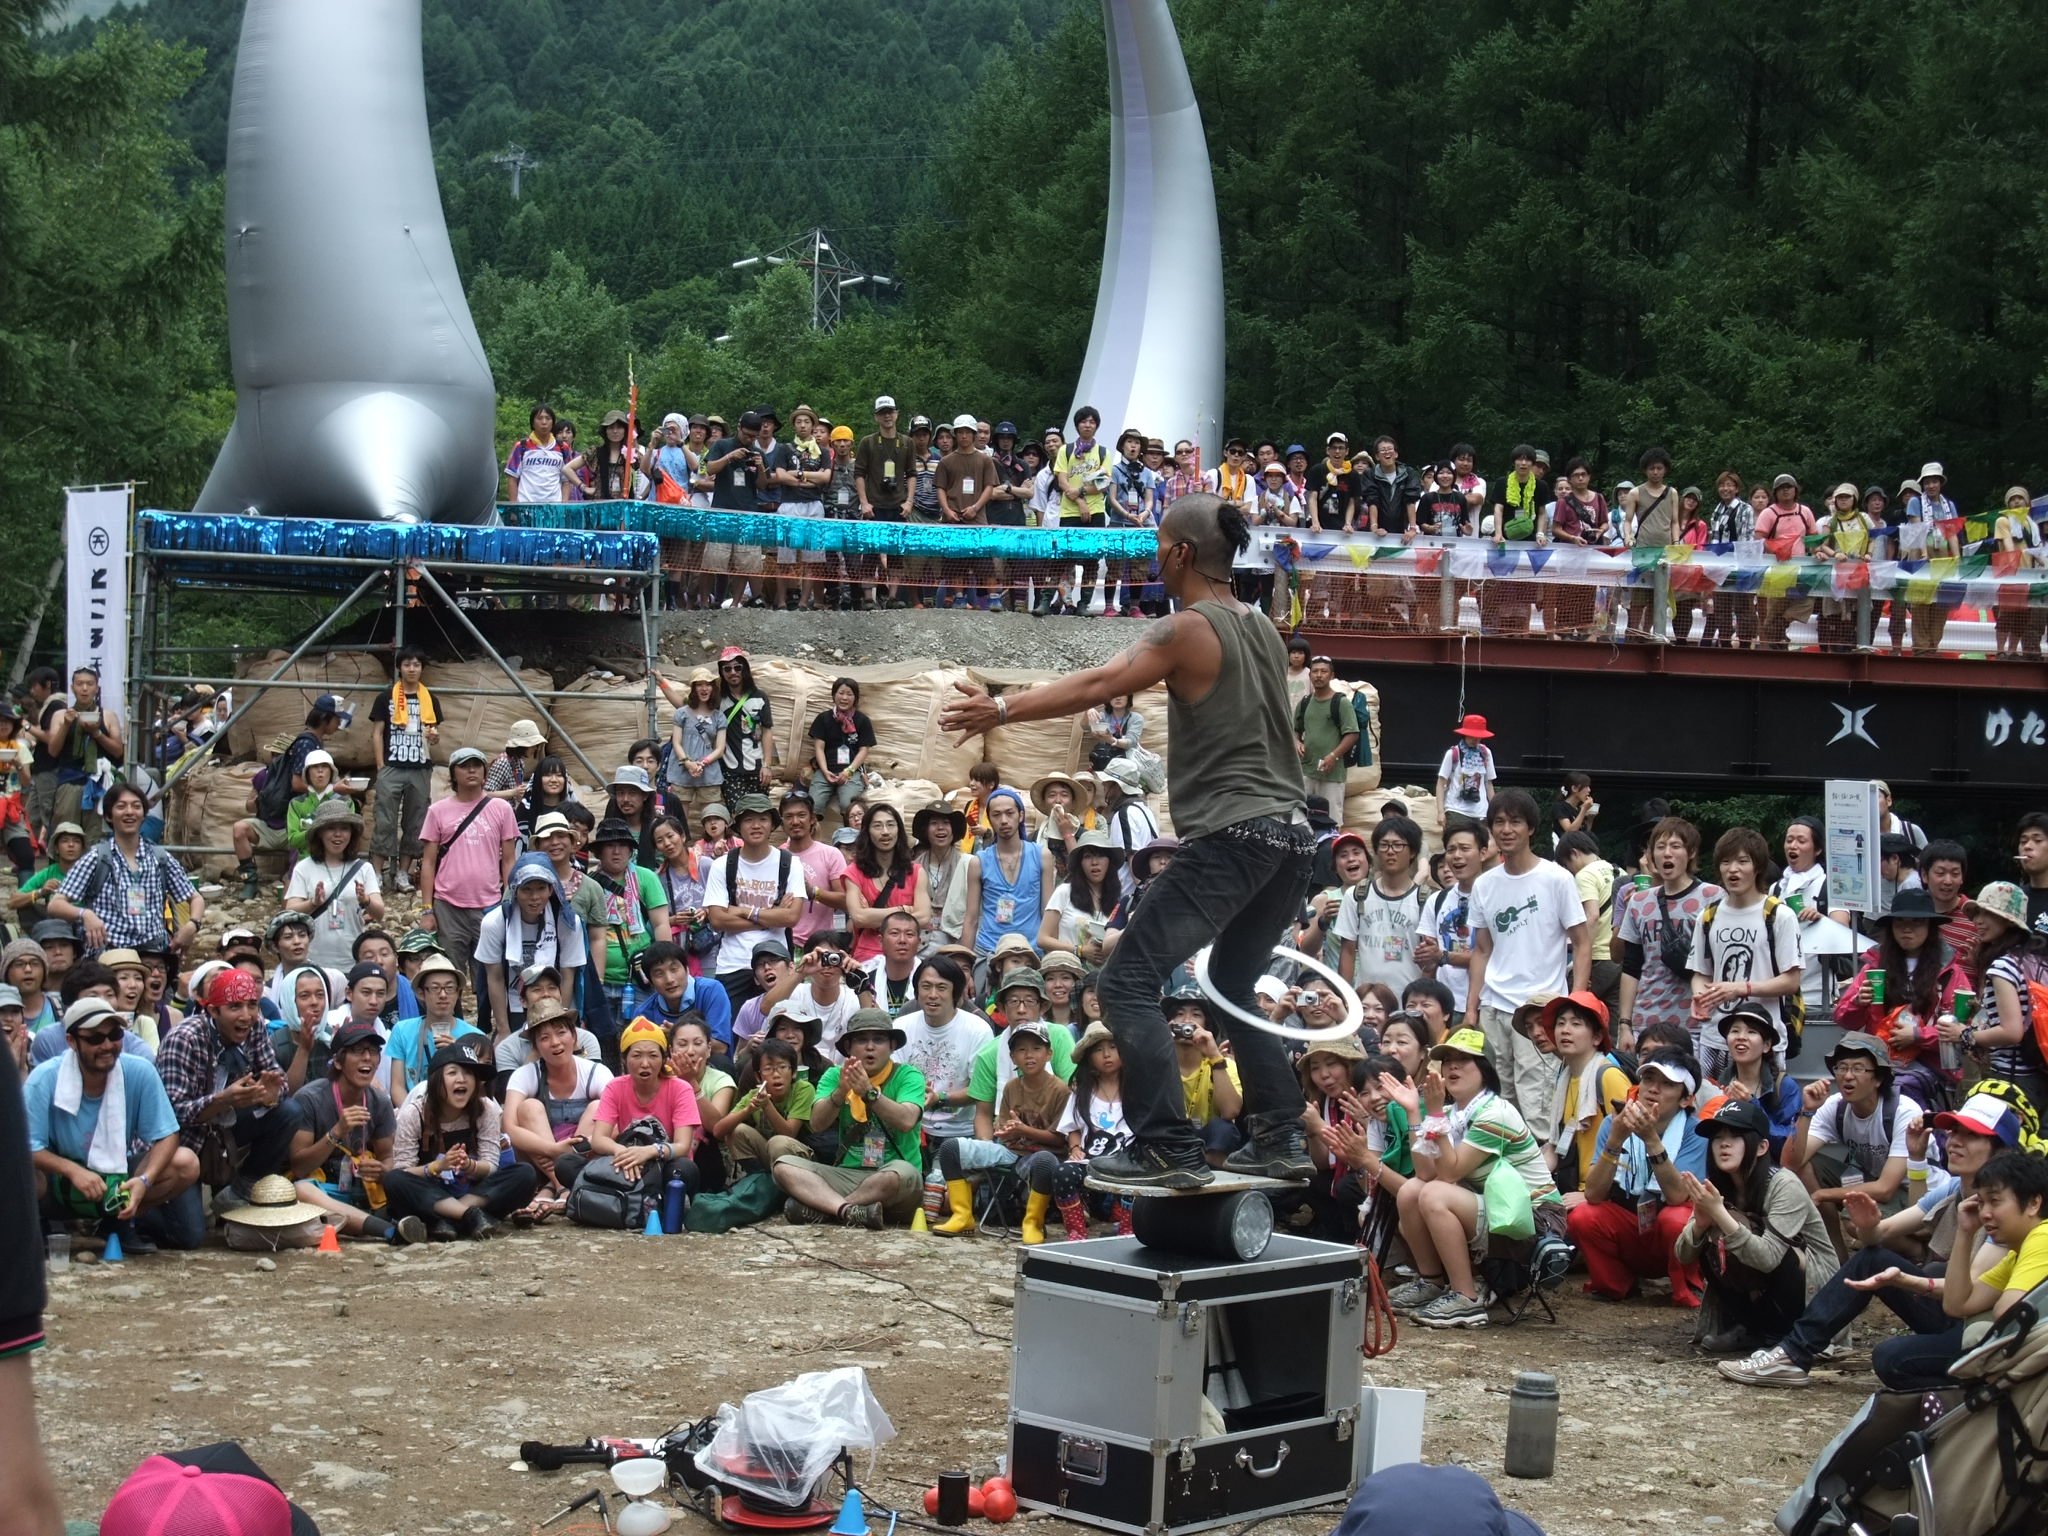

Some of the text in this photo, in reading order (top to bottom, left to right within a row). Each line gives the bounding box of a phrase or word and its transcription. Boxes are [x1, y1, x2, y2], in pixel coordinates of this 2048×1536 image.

[1363, 908, 1413, 929] NEW YORK
[1716, 927, 1757, 944] ICON
